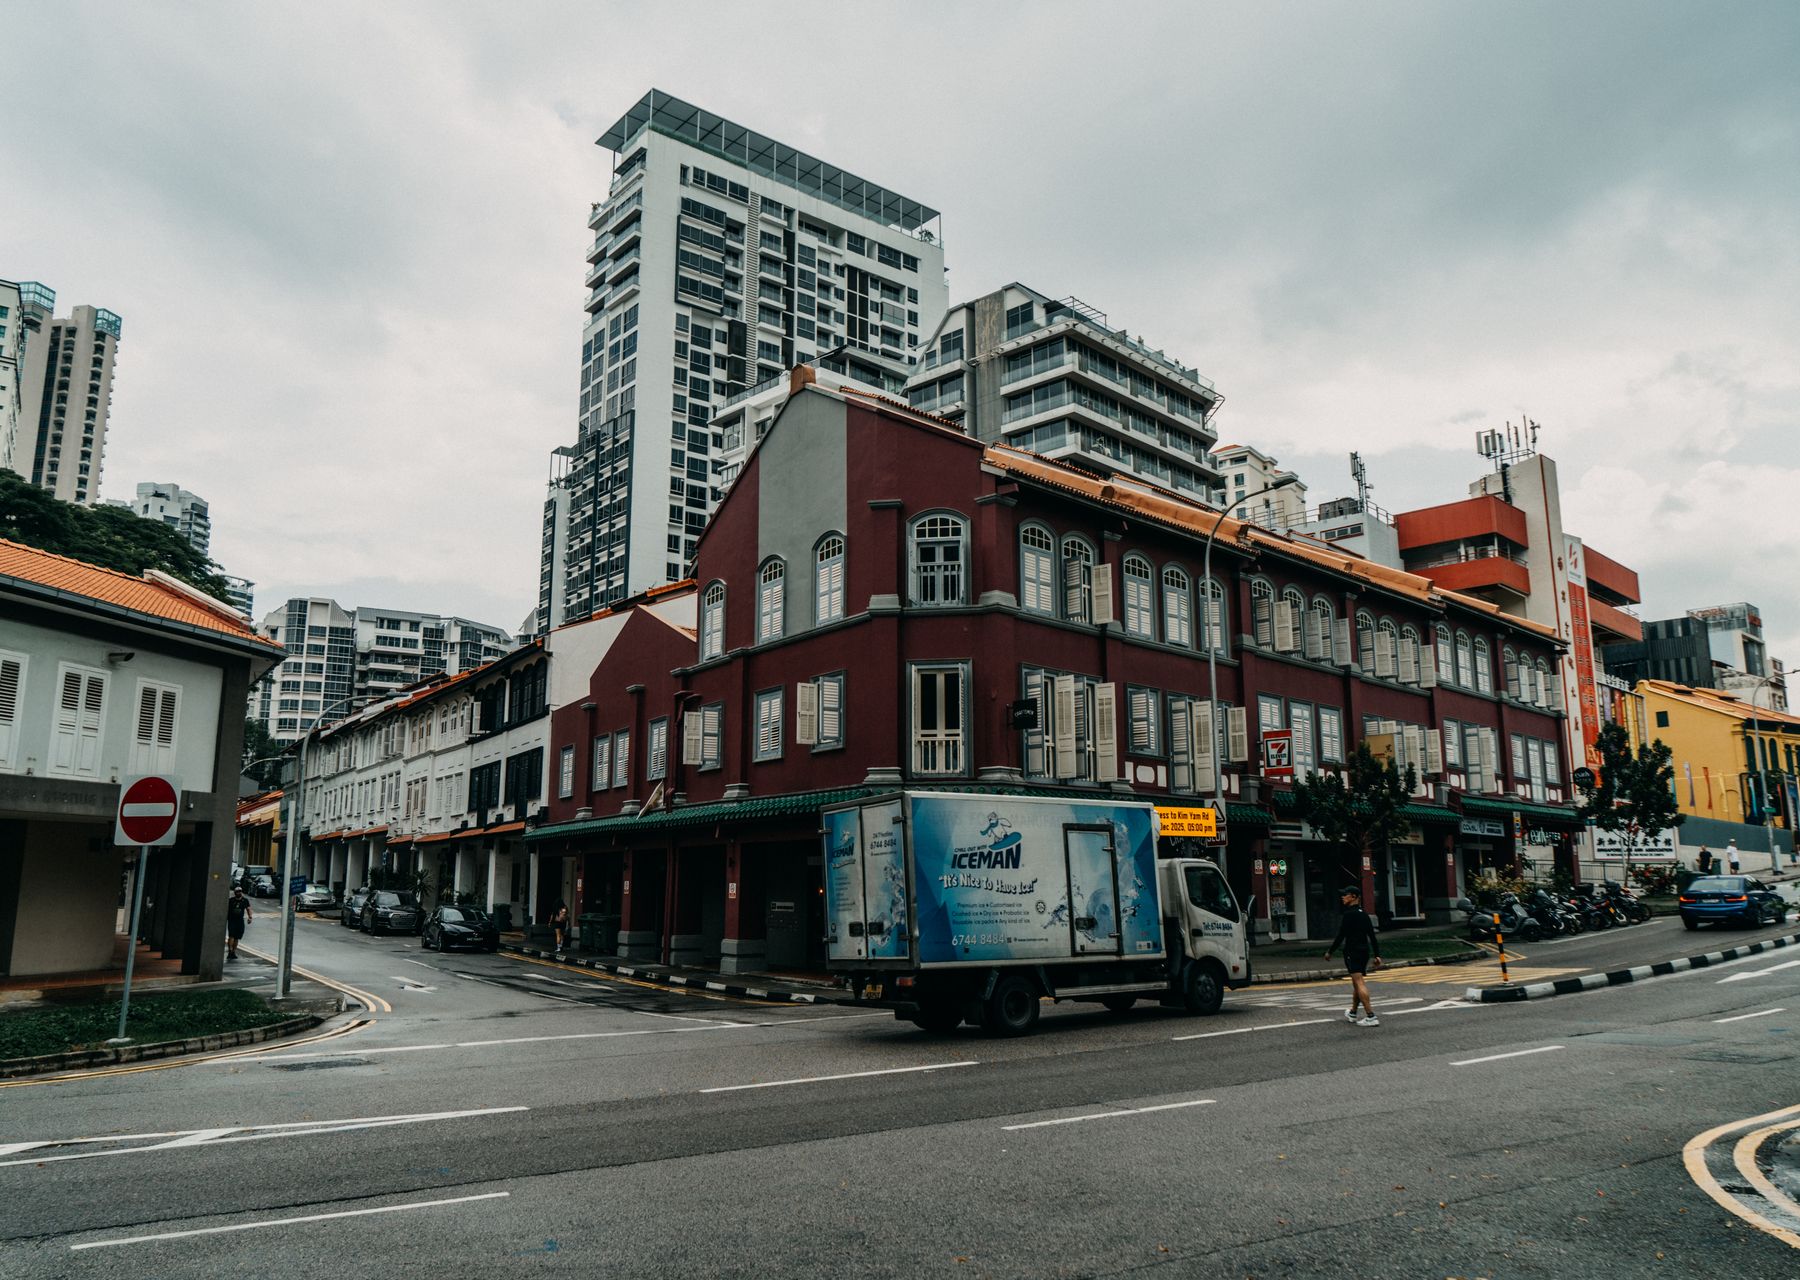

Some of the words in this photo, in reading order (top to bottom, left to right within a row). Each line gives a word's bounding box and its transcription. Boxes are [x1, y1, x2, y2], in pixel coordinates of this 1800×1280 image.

[1270, 742, 1286, 766] 7
[1170, 811, 1177, 820] to
[1177, 811, 1188, 820] Kim
[1189, 812, 1201, 820] Yam
[1202, 812, 1209, 821] Rd
[1170, 823, 1185, 832] 2025,
[1203, 826, 1213, 834] pm
[951, 842, 1022, 869] ICEMAN
[959, 873, 981, 889] Nice
[982, 877, 994, 891] To
[995, 880, 1017, 895] Have
[951, 934, 977, 946] 6744
[980, 933, 1005, 945] 8484
